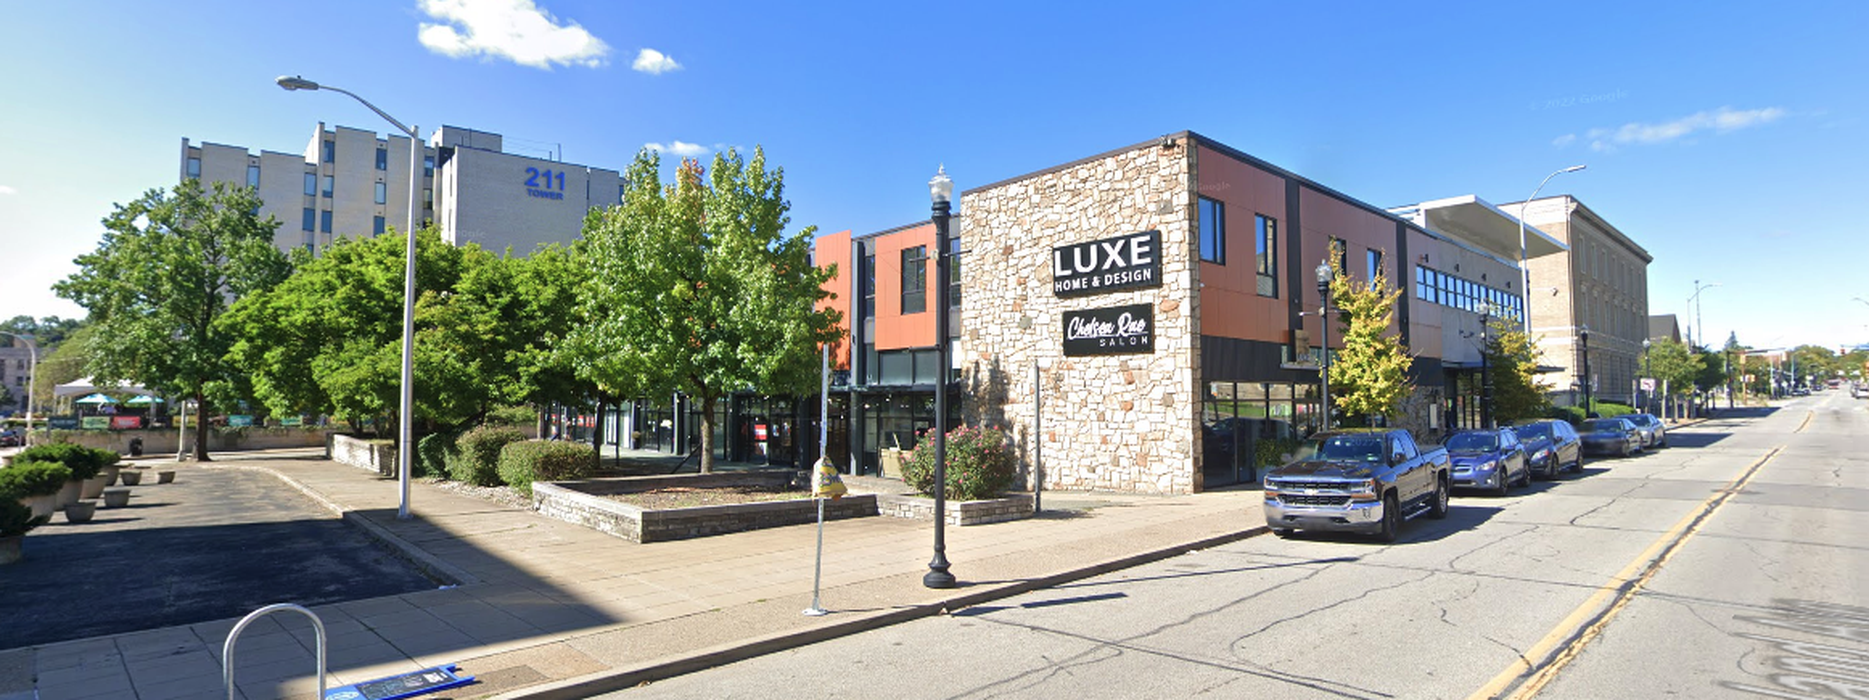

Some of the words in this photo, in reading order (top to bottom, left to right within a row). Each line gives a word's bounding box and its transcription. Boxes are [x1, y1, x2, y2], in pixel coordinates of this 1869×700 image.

[524, 167, 565, 191] 211
[526, 188, 564, 200] TOWER
[1054, 235, 1152, 277] LUXE
[1055, 278, 1088, 292] HOME
[1092, 276, 1101, 287] &
[1104, 268, 1151, 286] DESIGN
[1067, 316, 1115, 340] Chelsea
[1099, 336, 1148, 347] SALON
